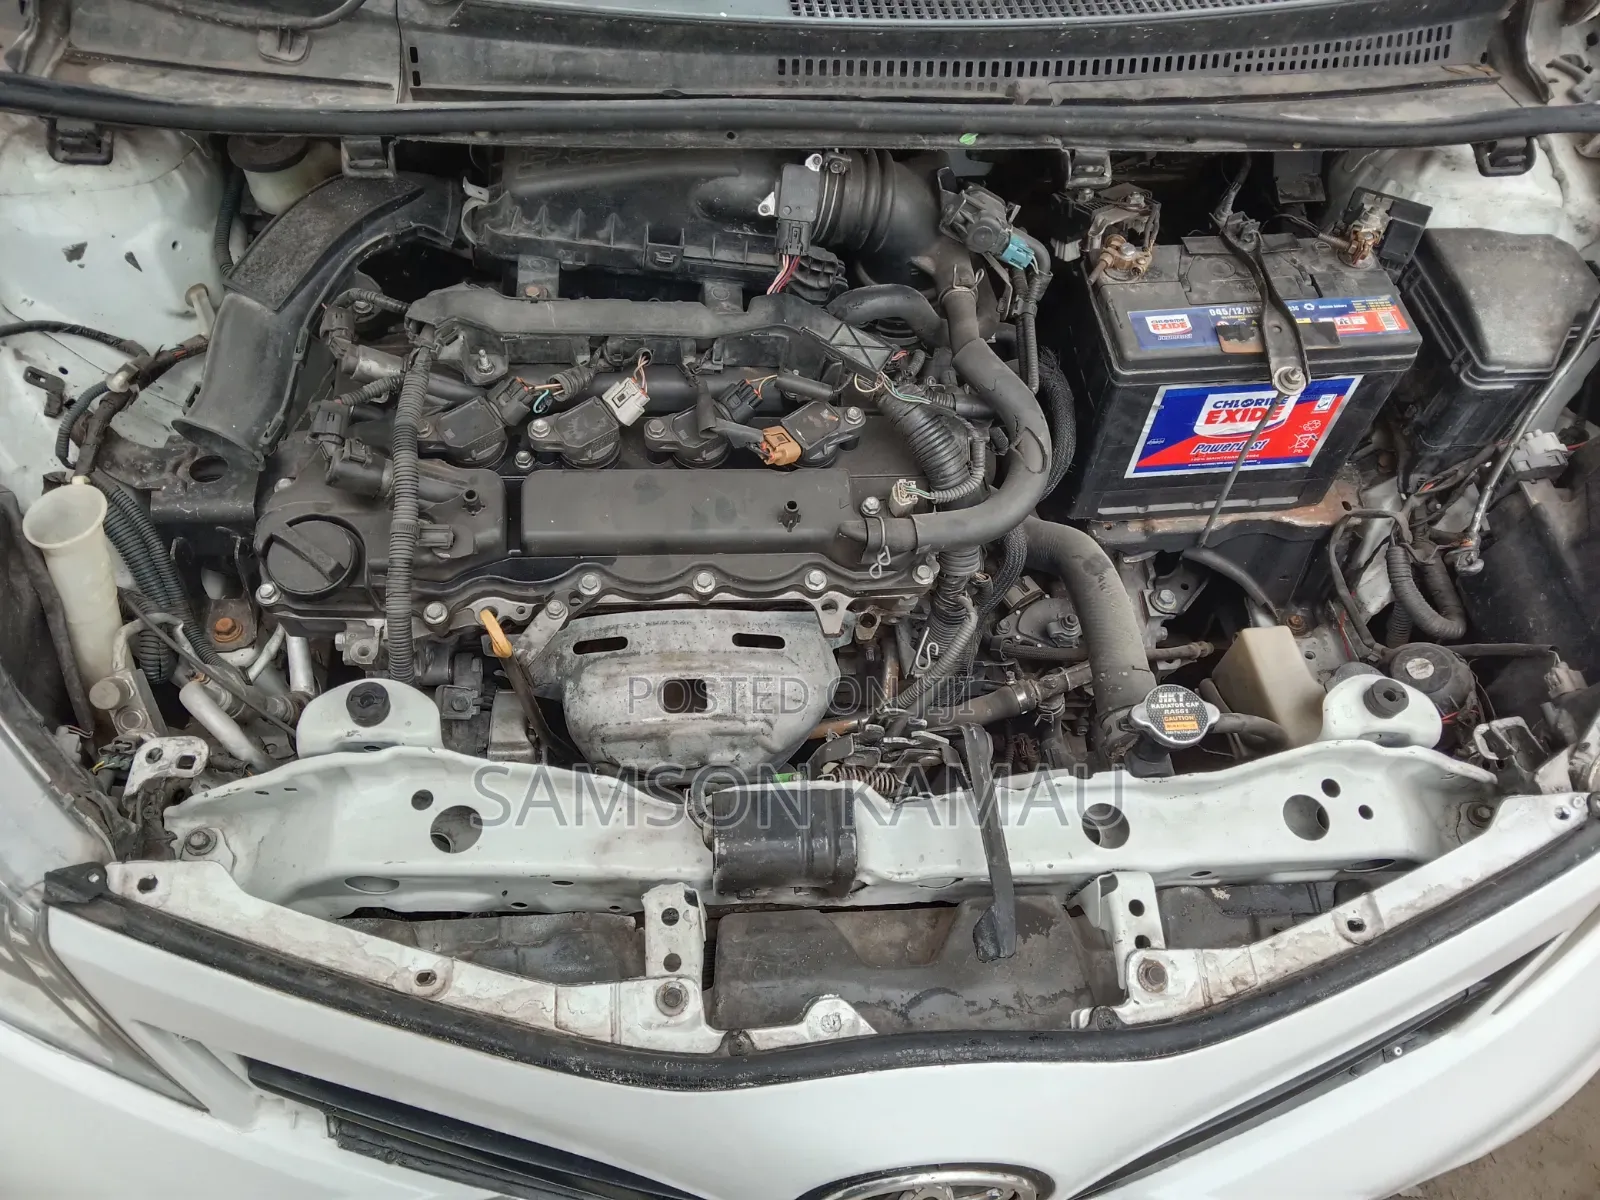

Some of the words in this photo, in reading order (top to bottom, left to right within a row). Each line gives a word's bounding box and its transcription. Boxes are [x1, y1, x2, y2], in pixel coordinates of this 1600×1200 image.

[1152, 322, 1188, 330] EXIDE
[1204, 404, 1286, 424] EXIDE
[1190, 438, 1270, 455] PowerLst
[1158, 692, 1186, 703] HKT
